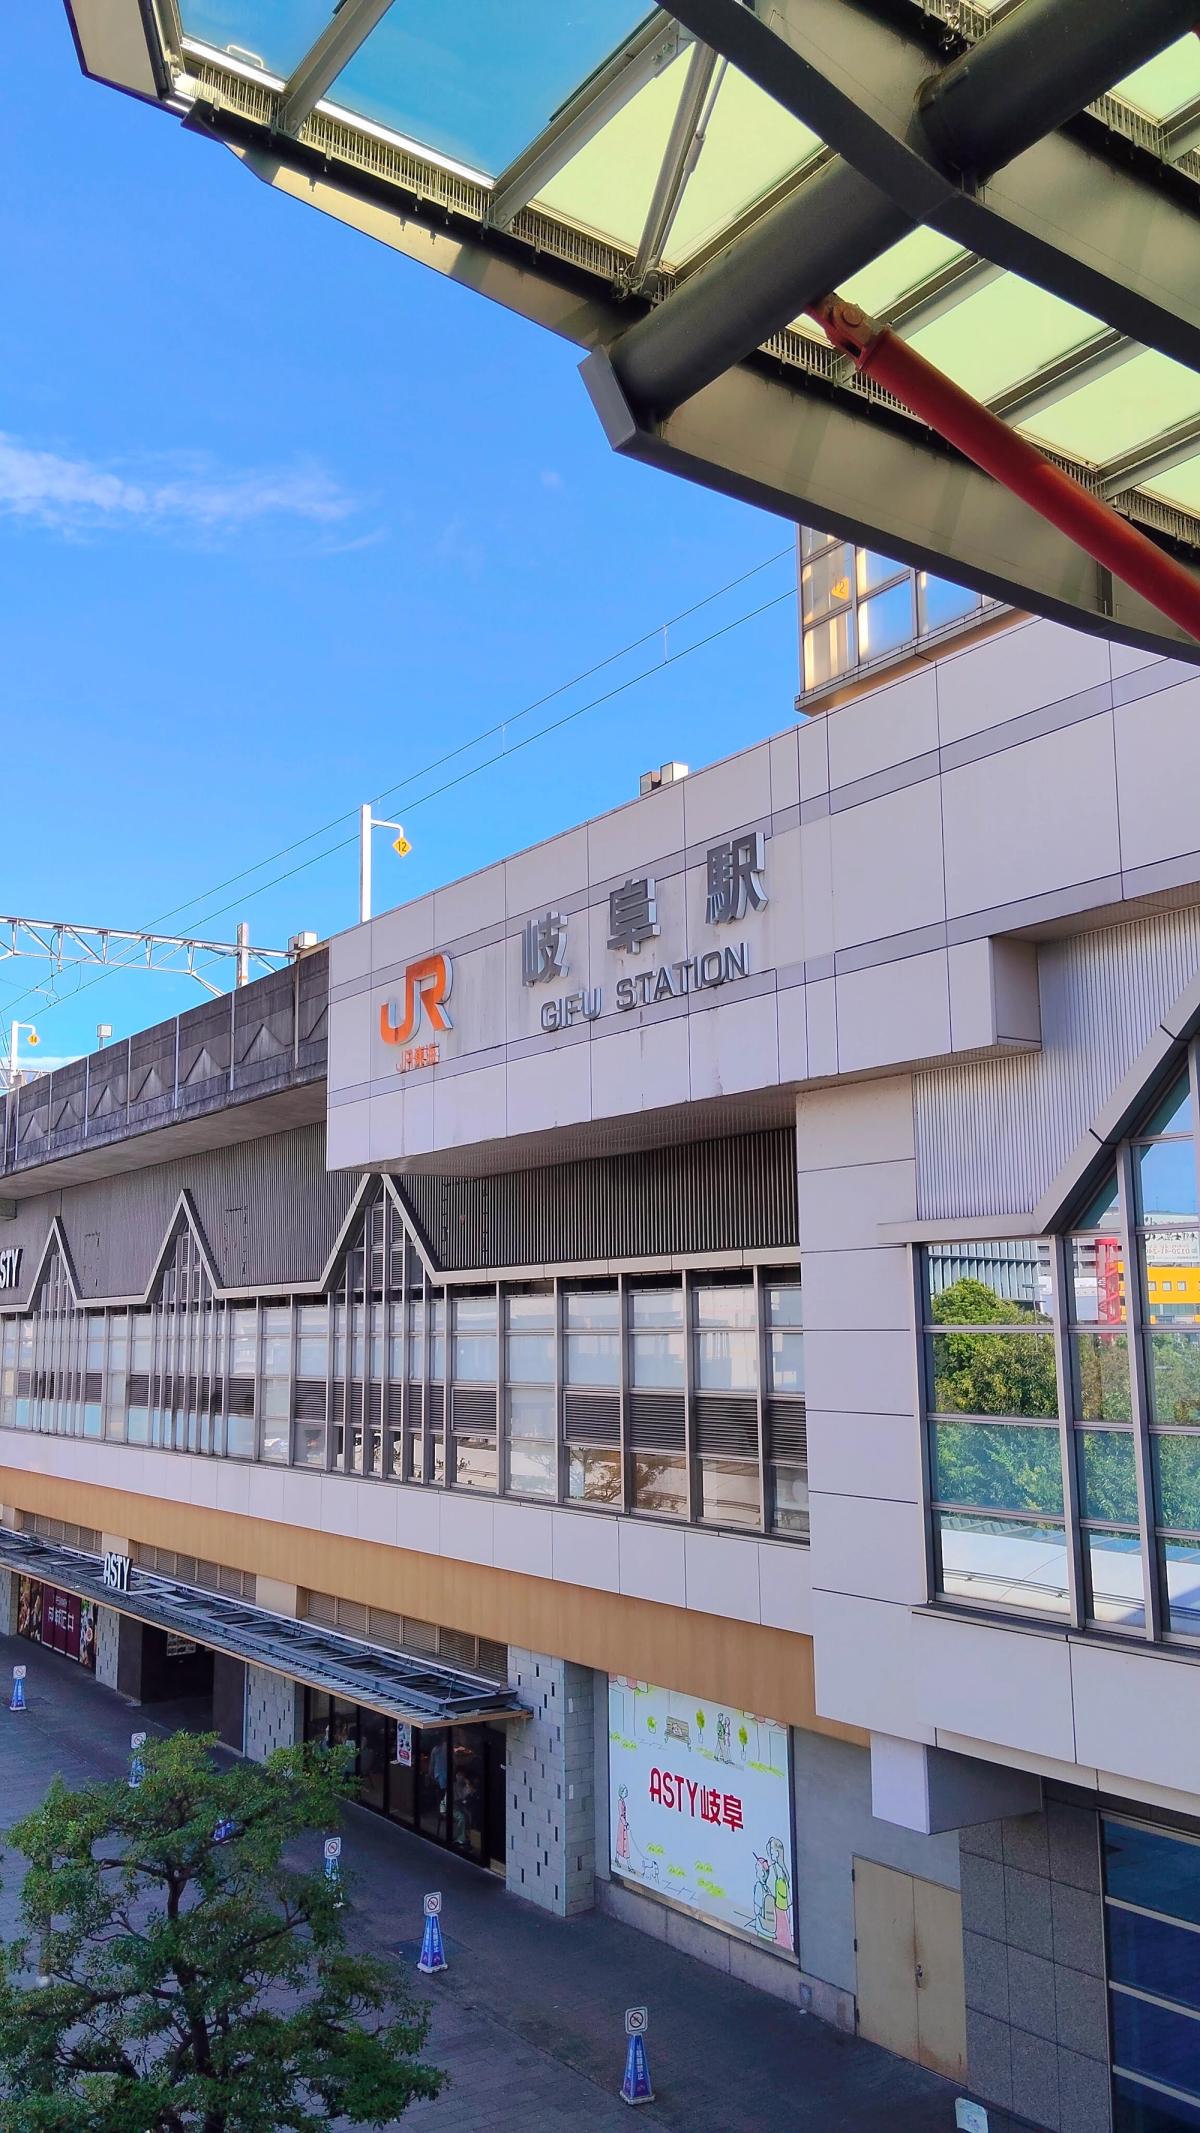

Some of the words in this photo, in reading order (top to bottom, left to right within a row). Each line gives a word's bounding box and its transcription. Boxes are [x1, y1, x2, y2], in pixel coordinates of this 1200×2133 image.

[522, 832, 769, 987] 岐阜駅
[380, 951, 454, 1045] JR
[541, 986, 603, 1032] GIFU
[616, 942, 750, 1011] STATION
[103, 1552, 131, 1591] ASTY
[649, 1767, 744, 1832] ASTY岐阜
